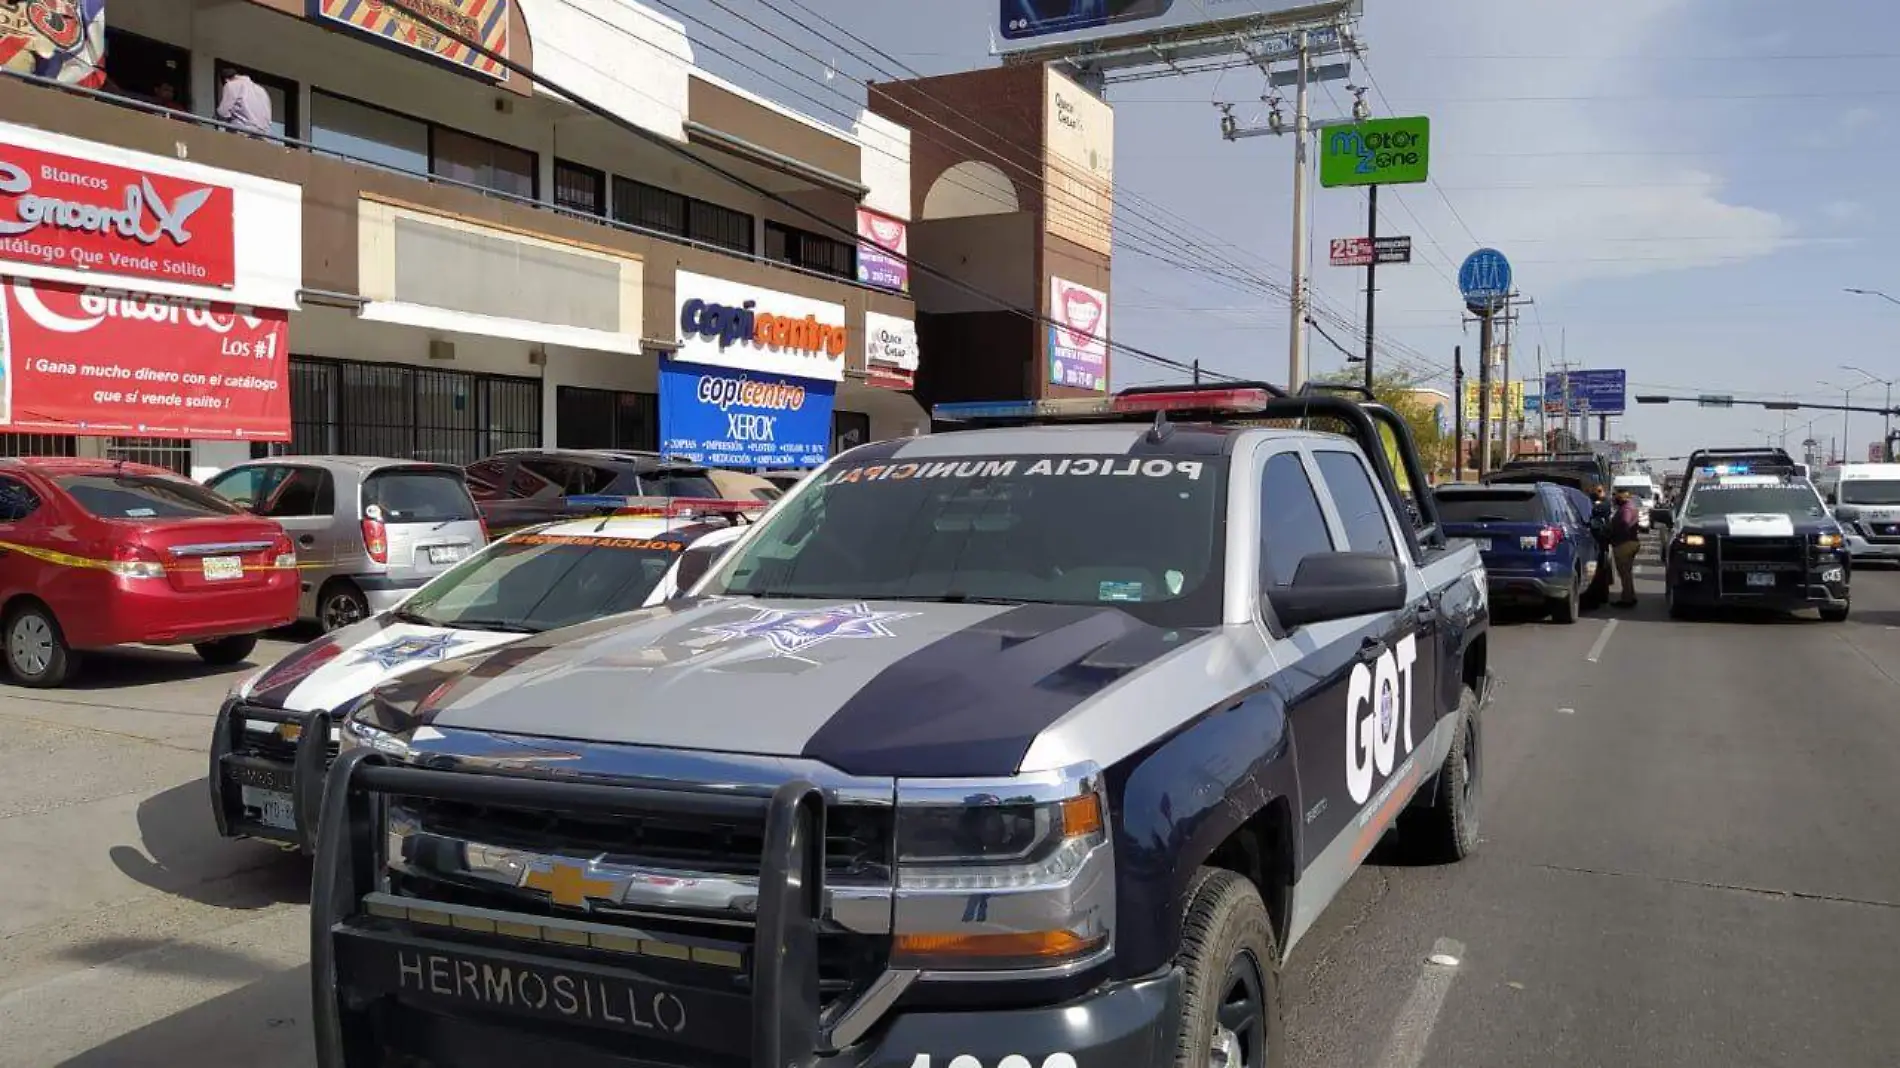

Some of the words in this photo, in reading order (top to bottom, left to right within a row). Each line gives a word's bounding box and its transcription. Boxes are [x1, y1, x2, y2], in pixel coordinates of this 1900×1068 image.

[41, 164, 109, 190] Blancos
[71, 247, 104, 267] Que
[110, 251, 158, 272] Vende
[163, 258, 207, 278] Solito
[681, 298, 847, 359] copicentro
[222, 336, 251, 356] Los
[254, 332, 277, 360] #1
[36, 358, 76, 375] Gana
[81, 362, 131, 379] mucho
[135, 366, 179, 383] dinero
[182, 372, 206, 385] con
[209, 373, 222, 386] el
[225, 375, 279, 391] catálogo
[93, 389, 122, 404] que
[125, 388, 139, 403] sí
[142, 391, 182, 408] vende
[186, 393, 222, 410] solito
[697, 373, 805, 411] copicentro
[726, 413, 777, 441] XEROX
[1346, 632, 1417, 805] GOT
[398, 950, 687, 1034] HERMOSILLO
